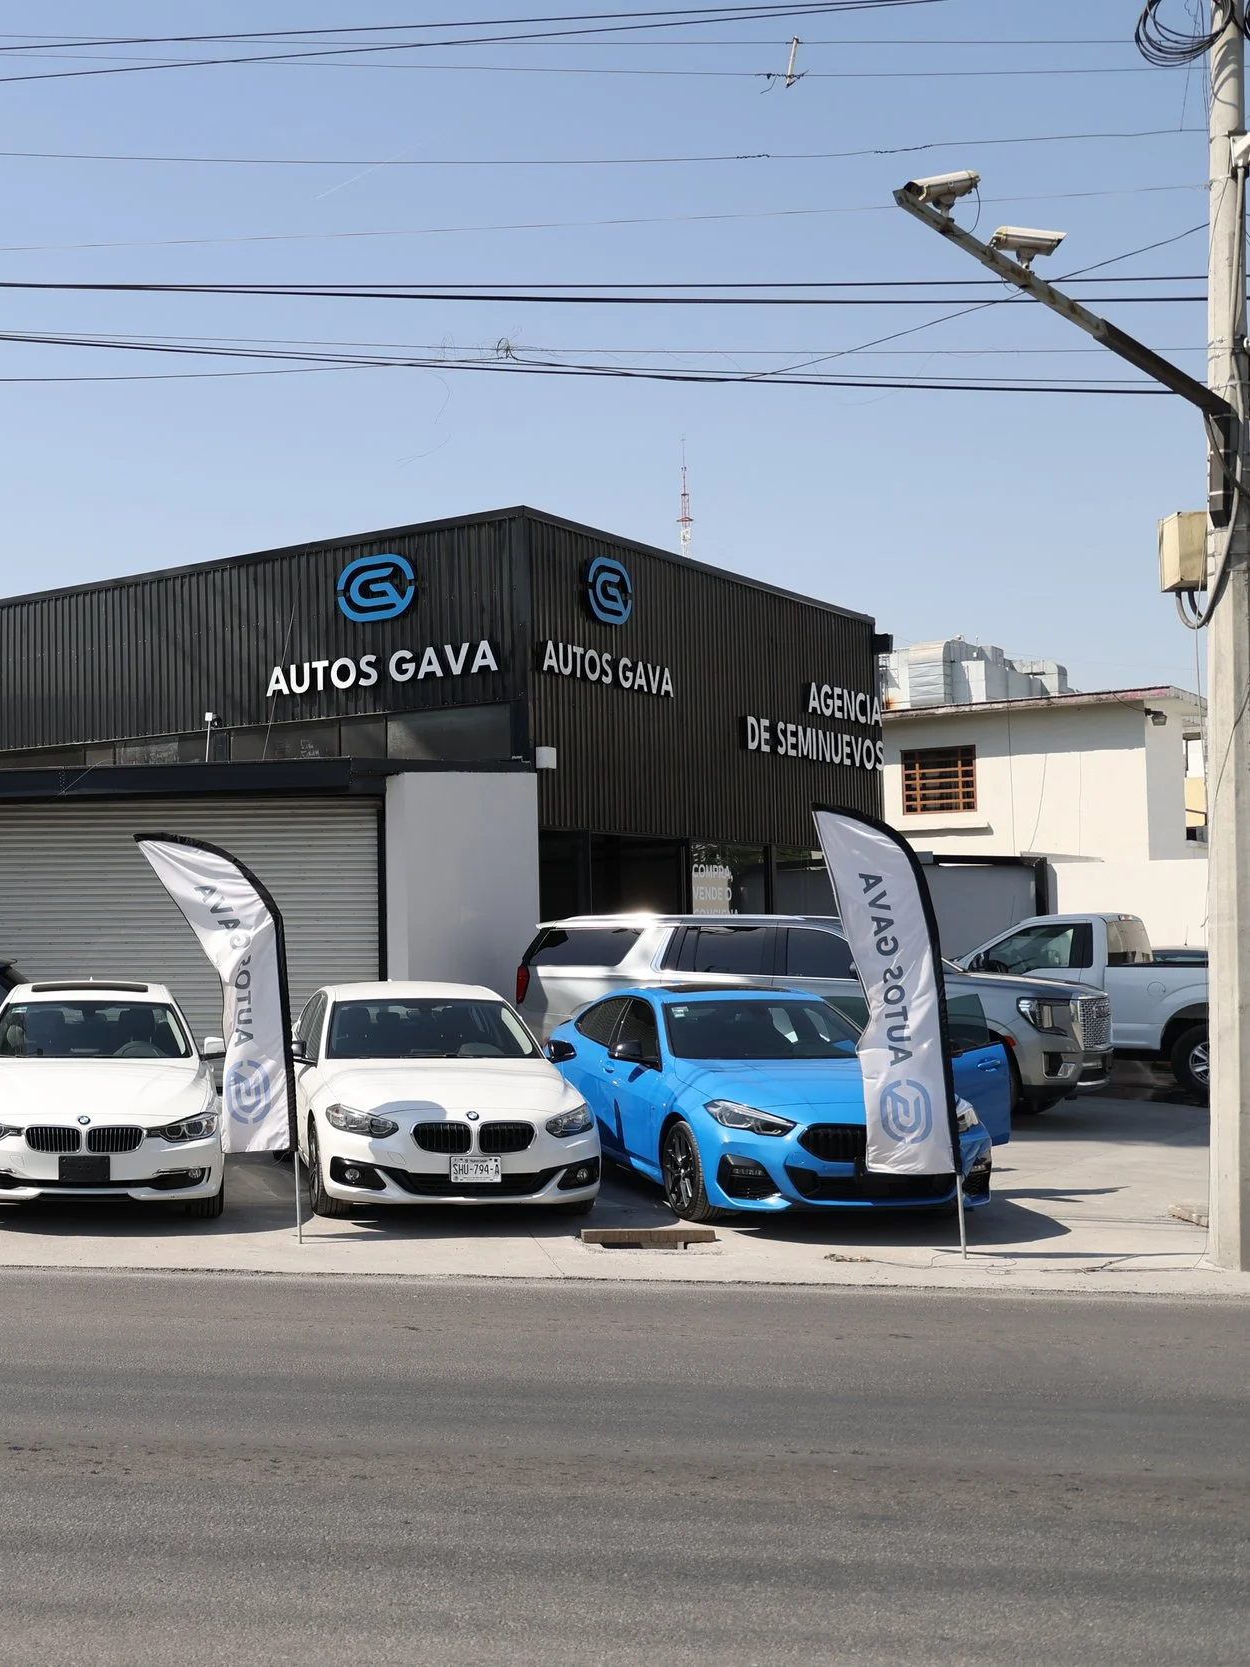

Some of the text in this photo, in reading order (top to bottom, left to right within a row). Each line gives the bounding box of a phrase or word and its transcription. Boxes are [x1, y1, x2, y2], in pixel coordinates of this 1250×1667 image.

[266, 639, 499, 697] AUTOS GAVA
[542, 640, 675, 698] AUTOS GAVA
[808, 681, 883, 728] AGENCIA
[746, 715, 885, 771] DE SEMINUEVOS
[692, 886, 733, 902] VENDE O
[452, 1163, 500, 1175] SHU-794-A
